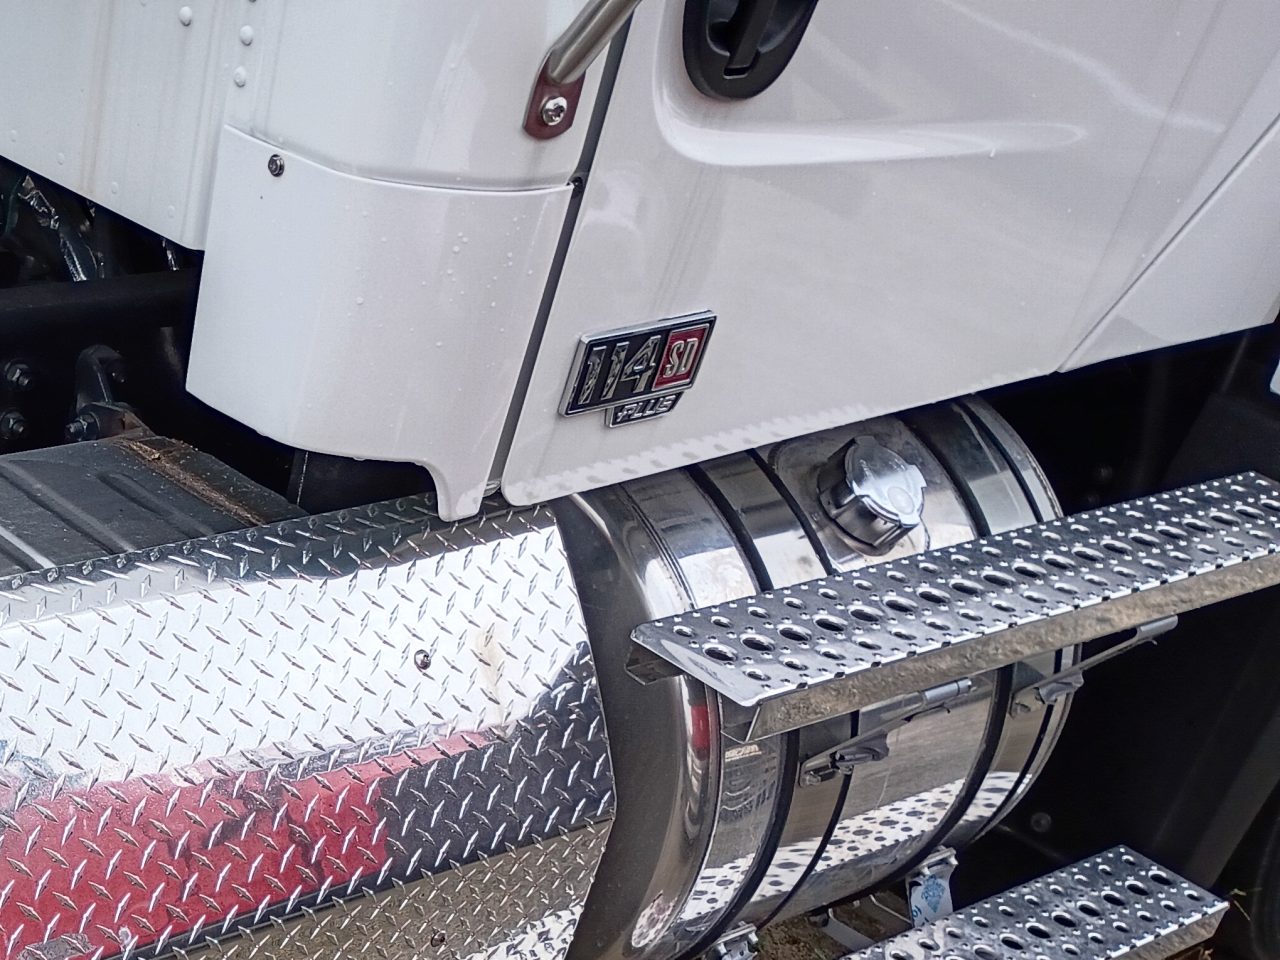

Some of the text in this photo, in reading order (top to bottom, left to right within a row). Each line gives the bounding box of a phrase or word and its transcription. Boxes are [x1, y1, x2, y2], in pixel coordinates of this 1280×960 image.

[577, 334, 699, 405] 114 SD
[616, 394, 677, 422] PLUS
